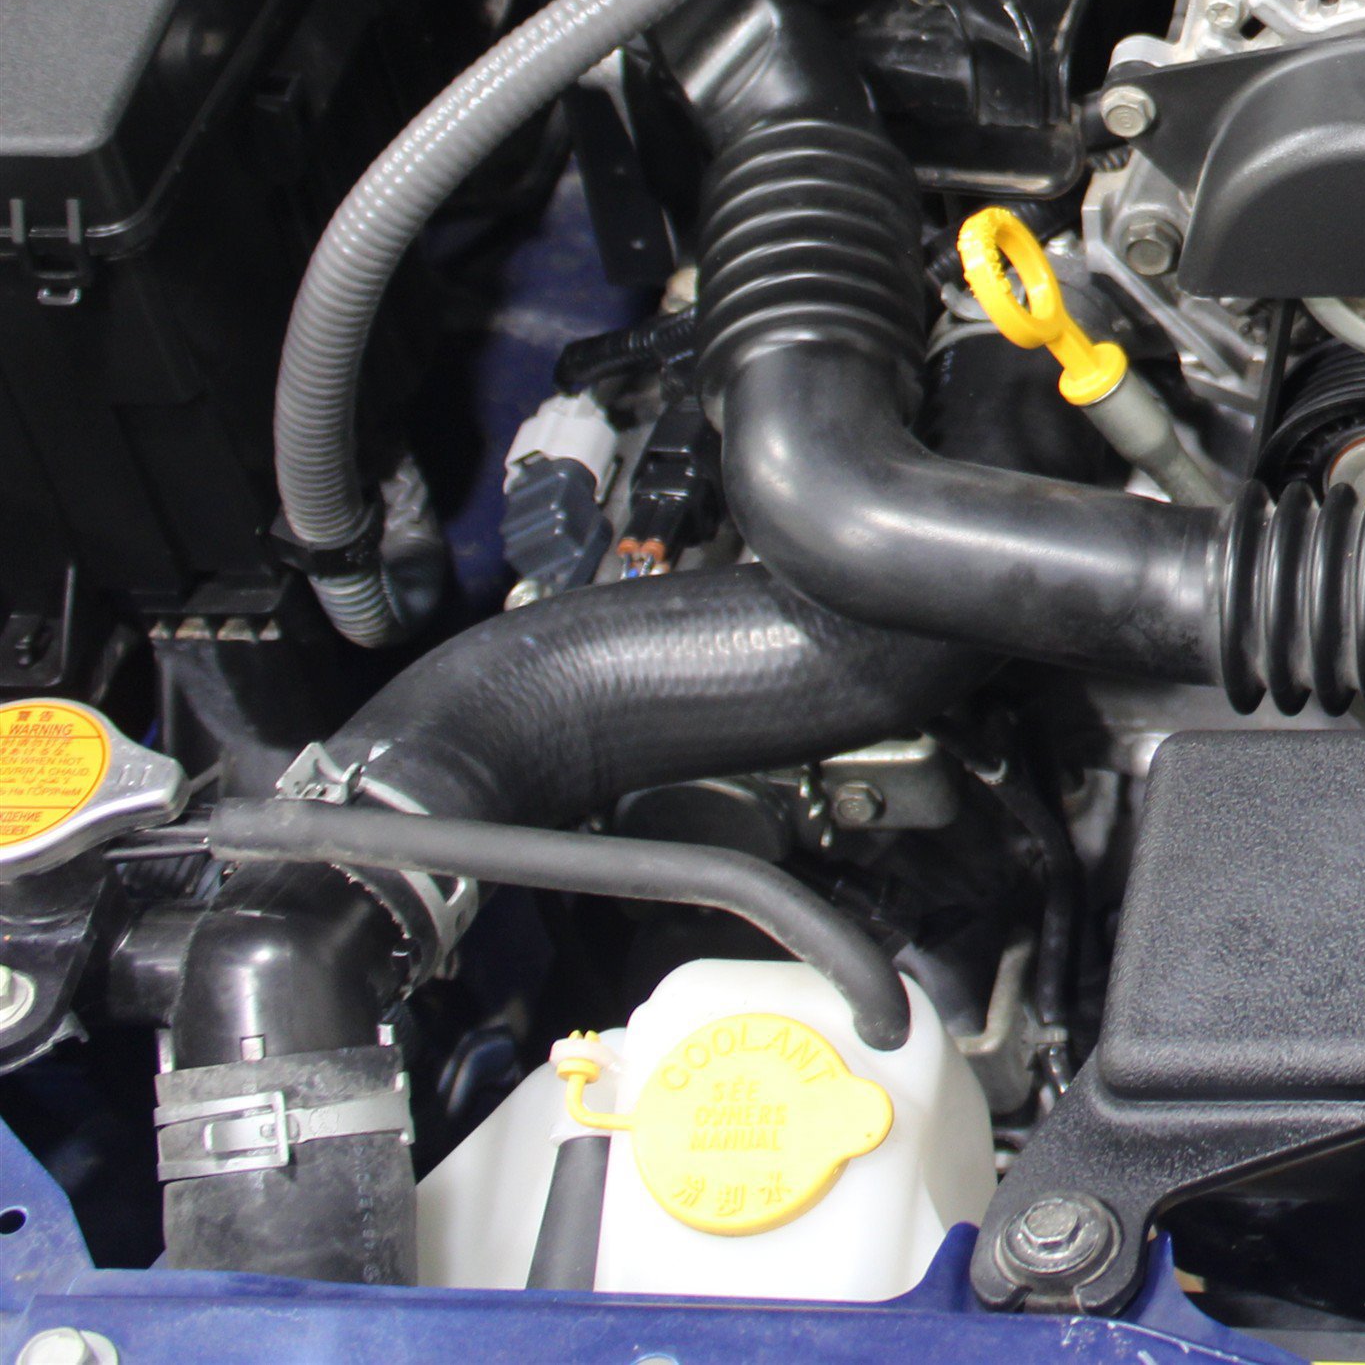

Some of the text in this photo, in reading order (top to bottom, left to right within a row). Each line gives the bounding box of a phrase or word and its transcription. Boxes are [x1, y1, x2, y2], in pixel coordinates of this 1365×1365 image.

[9, 723, 75, 736] WARNING
[659, 1020, 838, 1092] COOLANT
[712, 1080, 761, 1103] SEE
[690, 1129, 783, 1152] MANUAL
